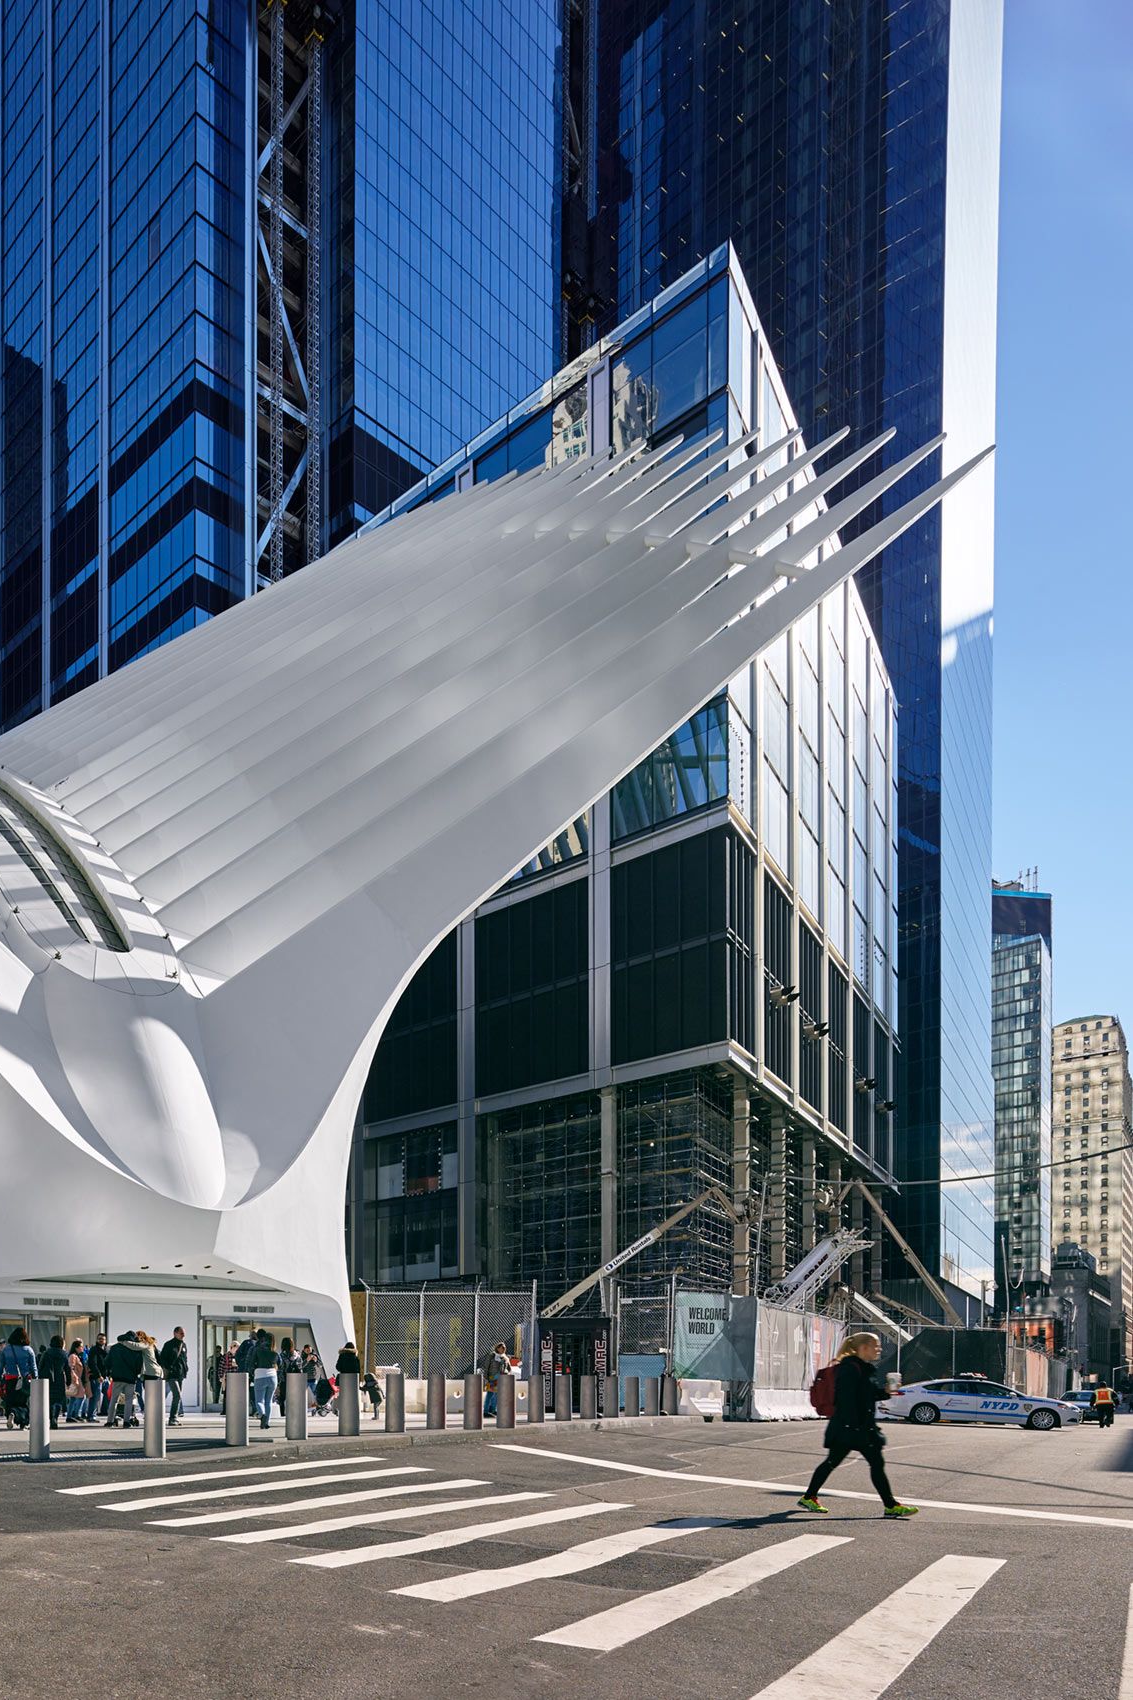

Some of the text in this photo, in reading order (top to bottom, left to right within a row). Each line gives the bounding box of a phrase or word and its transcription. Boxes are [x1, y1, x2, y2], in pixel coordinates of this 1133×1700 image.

[612, 1236, 651, 1265] United Rentals
[689, 1307, 729, 1321] WELCOME,
[688, 1321, 715, 1335] WORLD
[541, 1340, 553, 1372] MC
[980, 1401, 1019, 1411] NYPD
